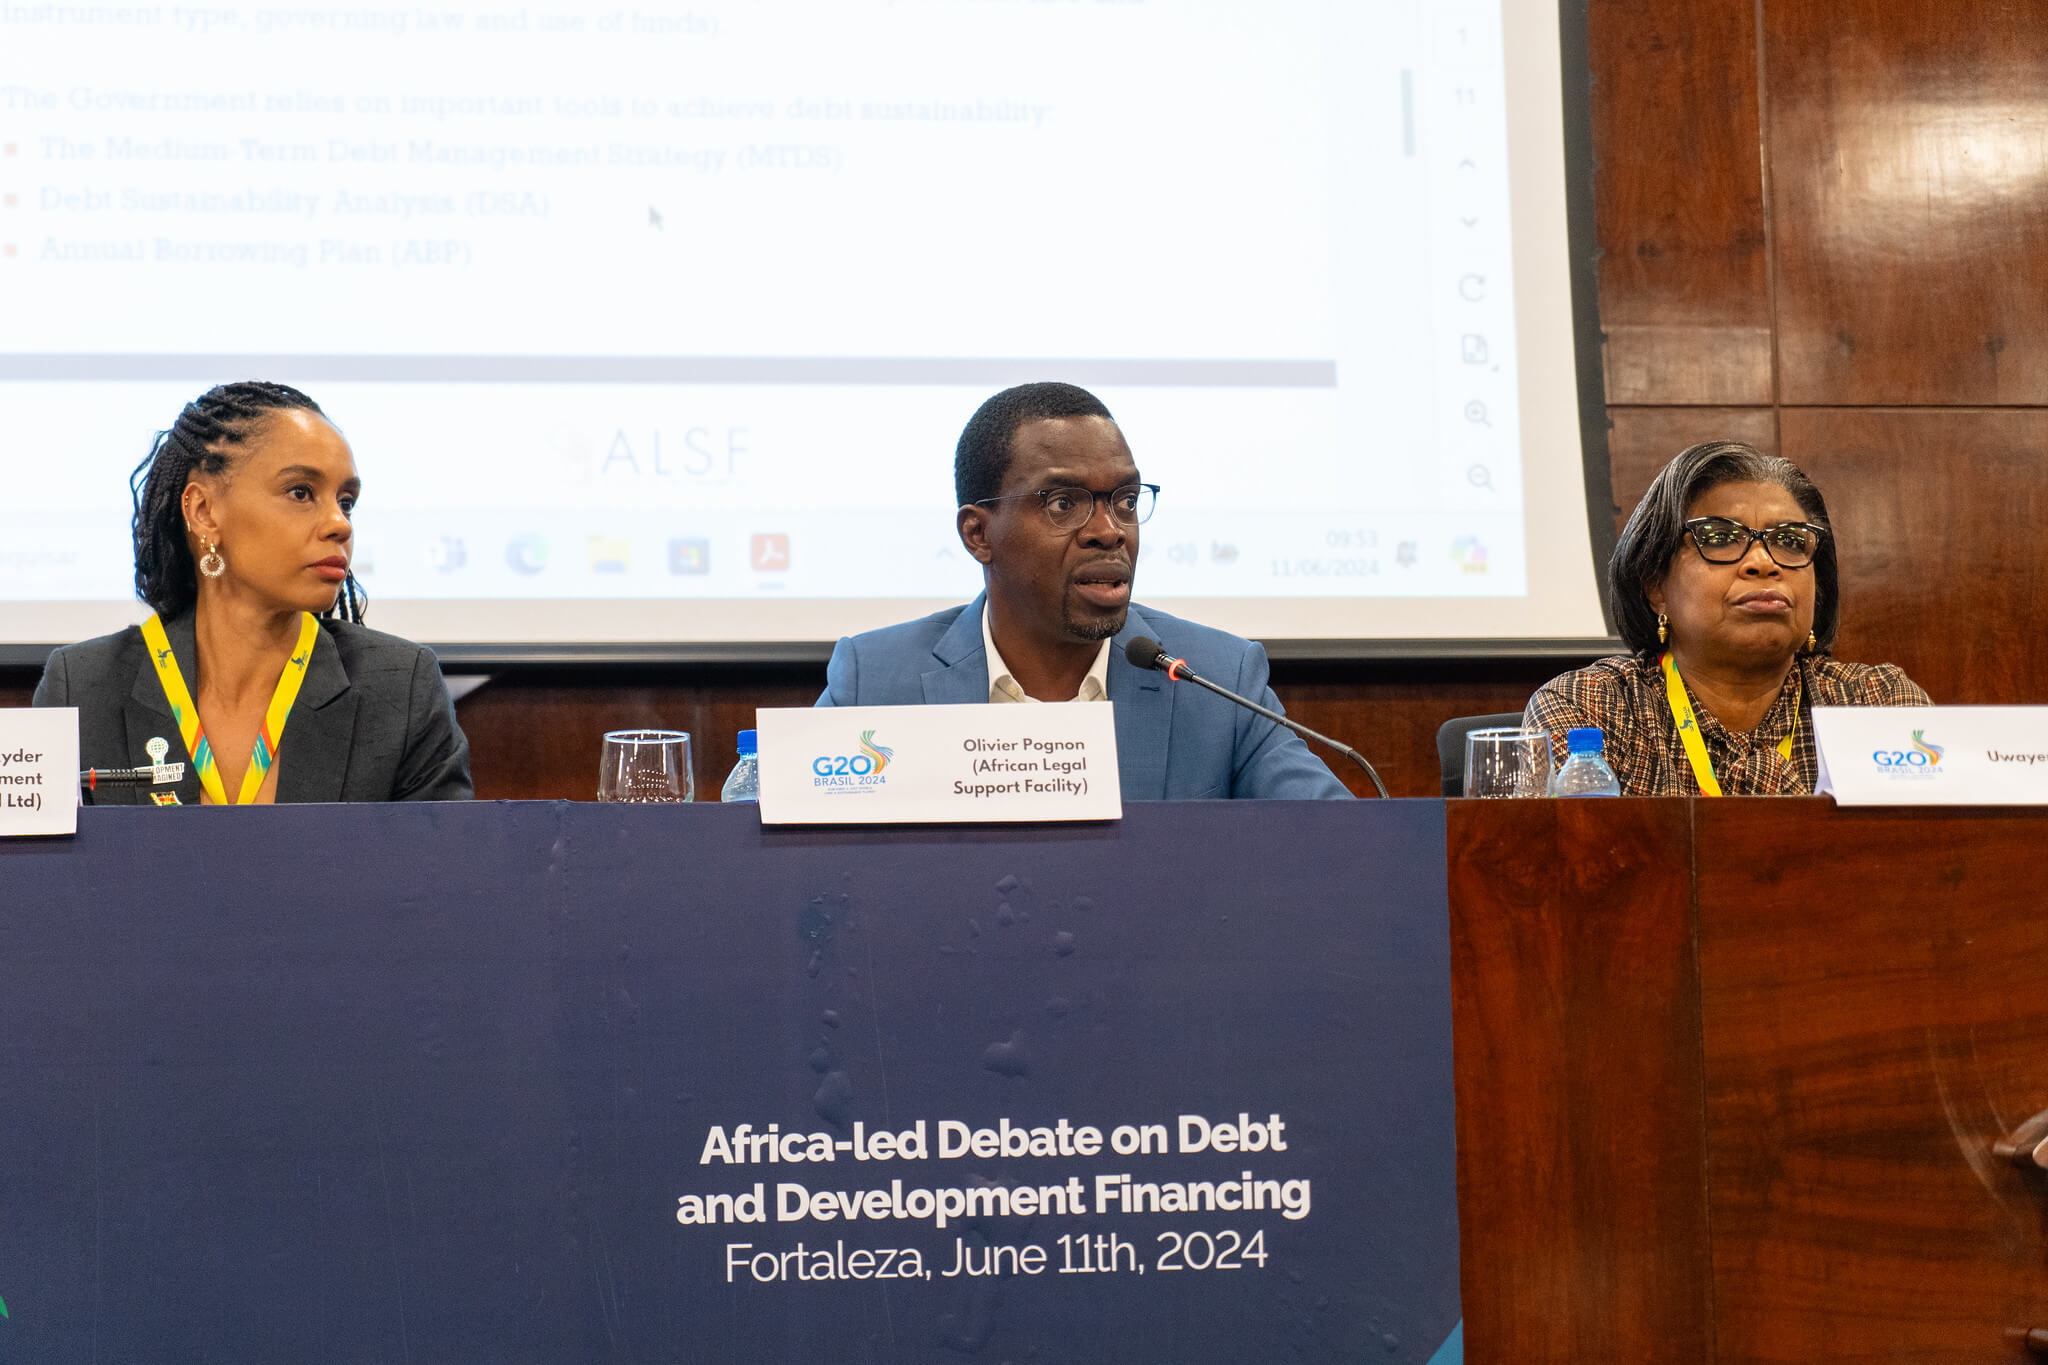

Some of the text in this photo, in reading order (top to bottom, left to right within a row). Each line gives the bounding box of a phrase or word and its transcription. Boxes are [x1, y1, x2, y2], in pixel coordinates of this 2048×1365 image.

[256, 9, 408, 36] governing
[416, 8, 464, 30] law
[476, 10, 529, 31] and
[538, 14, 586, 32] use
[597, 11, 624, 32] of
[2, 86, 57, 109] The
[69, 87, 258, 111] Government
[265, 91, 346, 114] relies
[355, 97, 392, 115] on
[400, 95, 545, 121] important
[554, 96, 624, 117] tools
[631, 98, 659, 117] to
[666, 97, 776, 118] achieve
[786, 97, 853, 120] debt
[39, 135, 843, 172] The Medium-Term Debt Management Strategy (MTDS)
[39, 186, 549, 218] Debt Sustainability Analysis (DSA)
[39, 236, 472, 268] Annual Borrowing Plan (ABP)
[601, 426, 748, 476] ALSF
[0, 748, 43, 766] yder
[963, 738, 1085, 754] Olivier Pognon
[1873, 750, 1927, 766] G20
[1987, 750, 2048, 765] Uwaye
[813, 755, 872, 777] G20
[972, 757, 1087, 775] (African Legal
[814, 775, 886, 786] BRASIL 2024
[953, 779, 1089, 798] Support Facility)
[8, 792, 42, 812] Ltd)
[700, 1113, 1287, 1164] Africa-led Debate on Debt
[676, 1170, 1311, 1228] and Development Financing
[726, 1230, 1269, 1283] Fortaleza, June 11th, 2024
